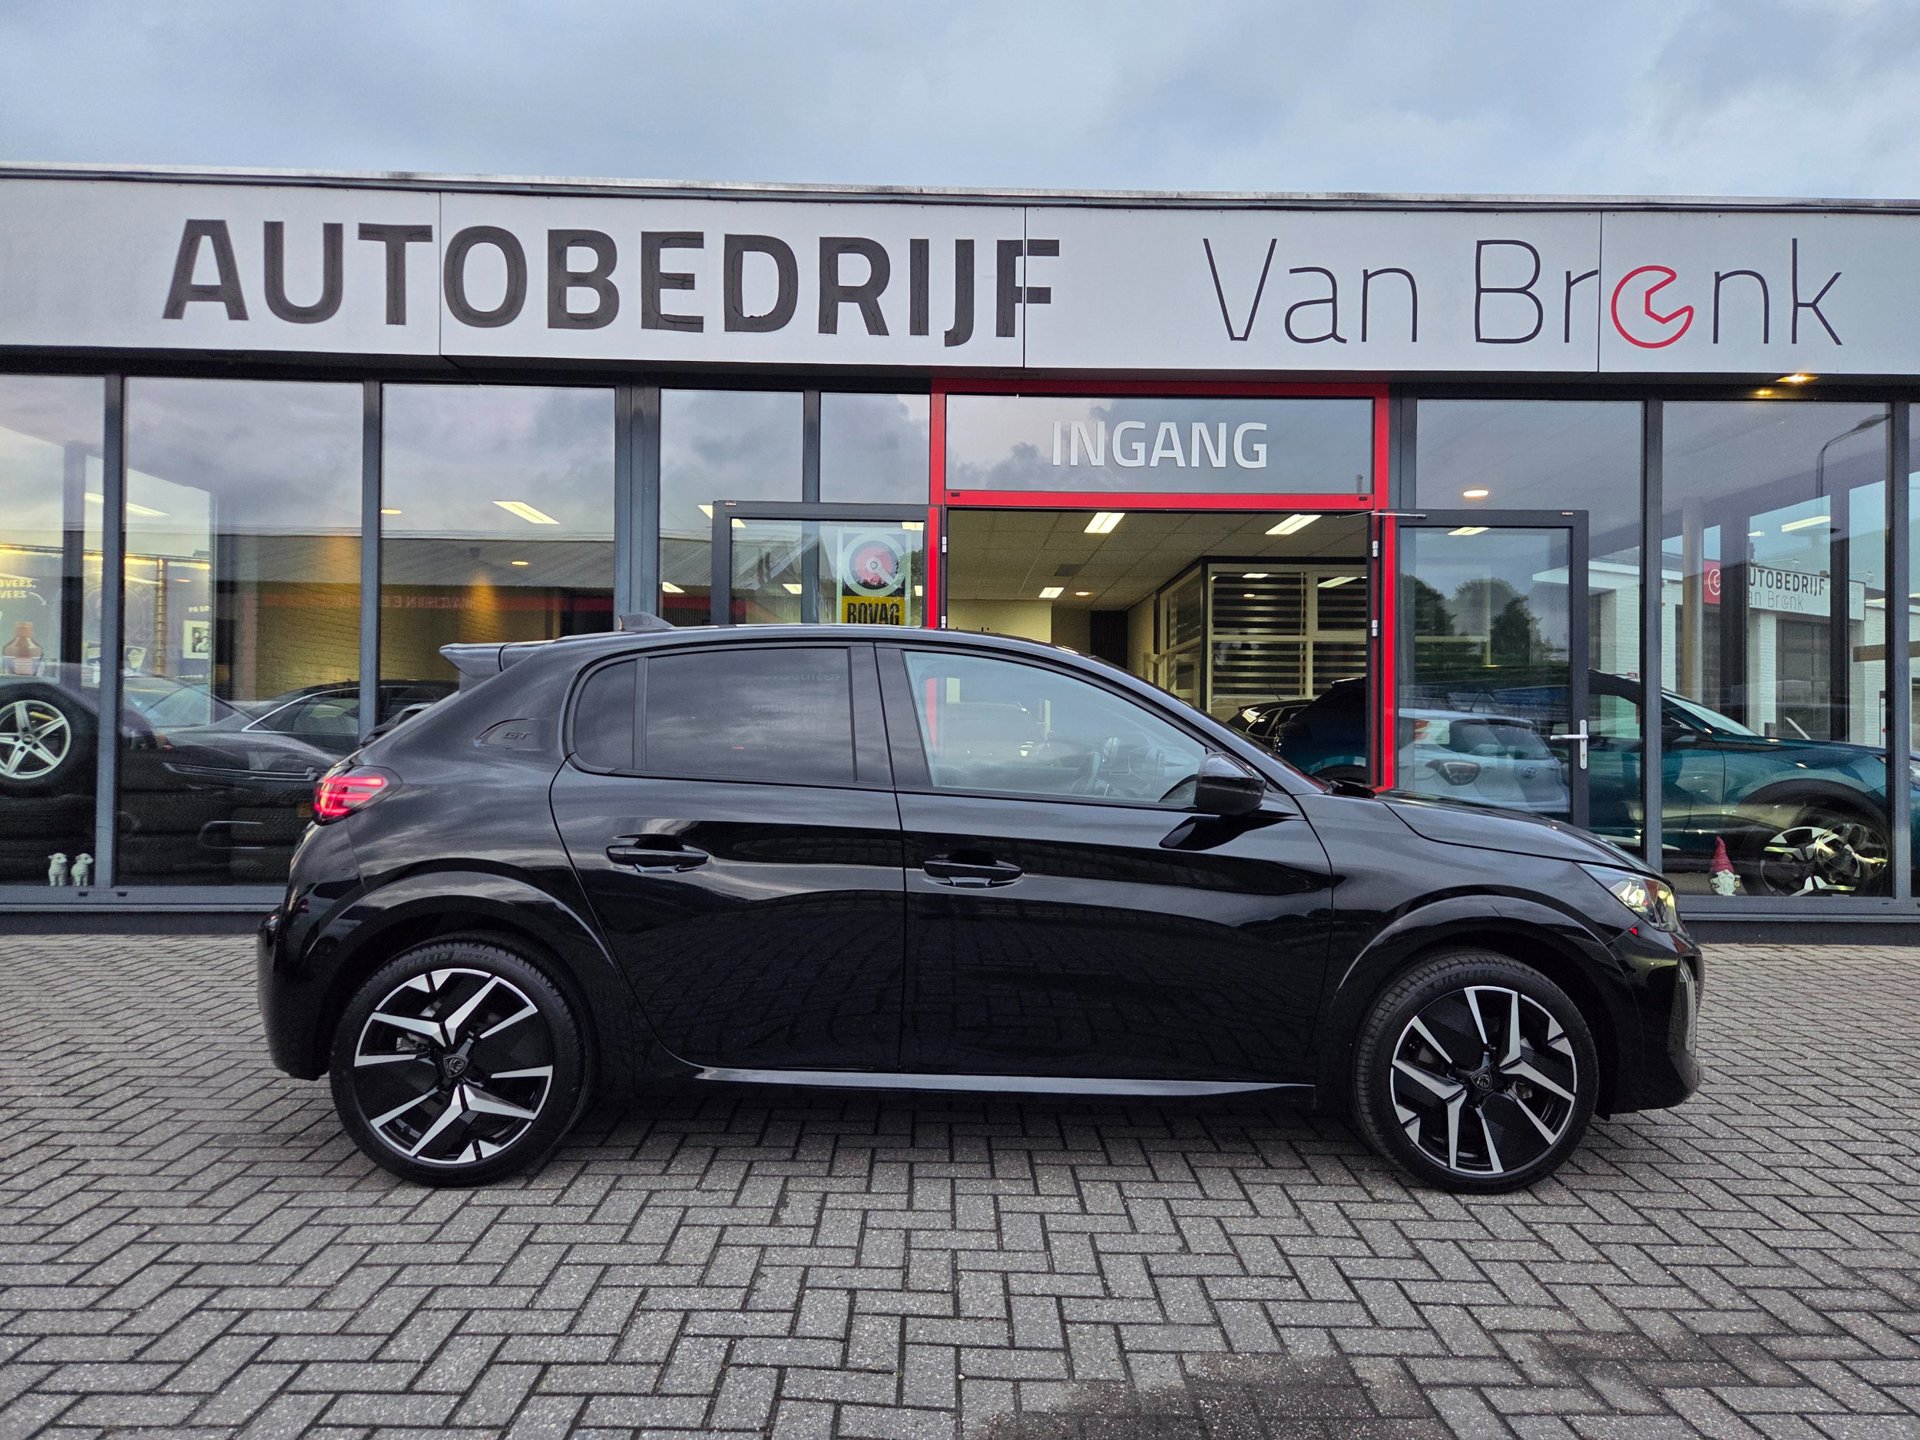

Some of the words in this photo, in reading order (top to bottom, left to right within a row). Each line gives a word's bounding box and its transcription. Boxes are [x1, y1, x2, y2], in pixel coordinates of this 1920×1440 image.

[163, 217, 1060, 345] AUTOBEDRIJF
[1203, 237, 1419, 344] Van
[1474, 236, 1844, 349] Bronk
[1050, 419, 1269, 469] INGANG
[1749, 568, 1825, 597] UTOBEDRIJF
[847, 602, 900, 625] BOVAG
[503, 732, 533, 740] GT
